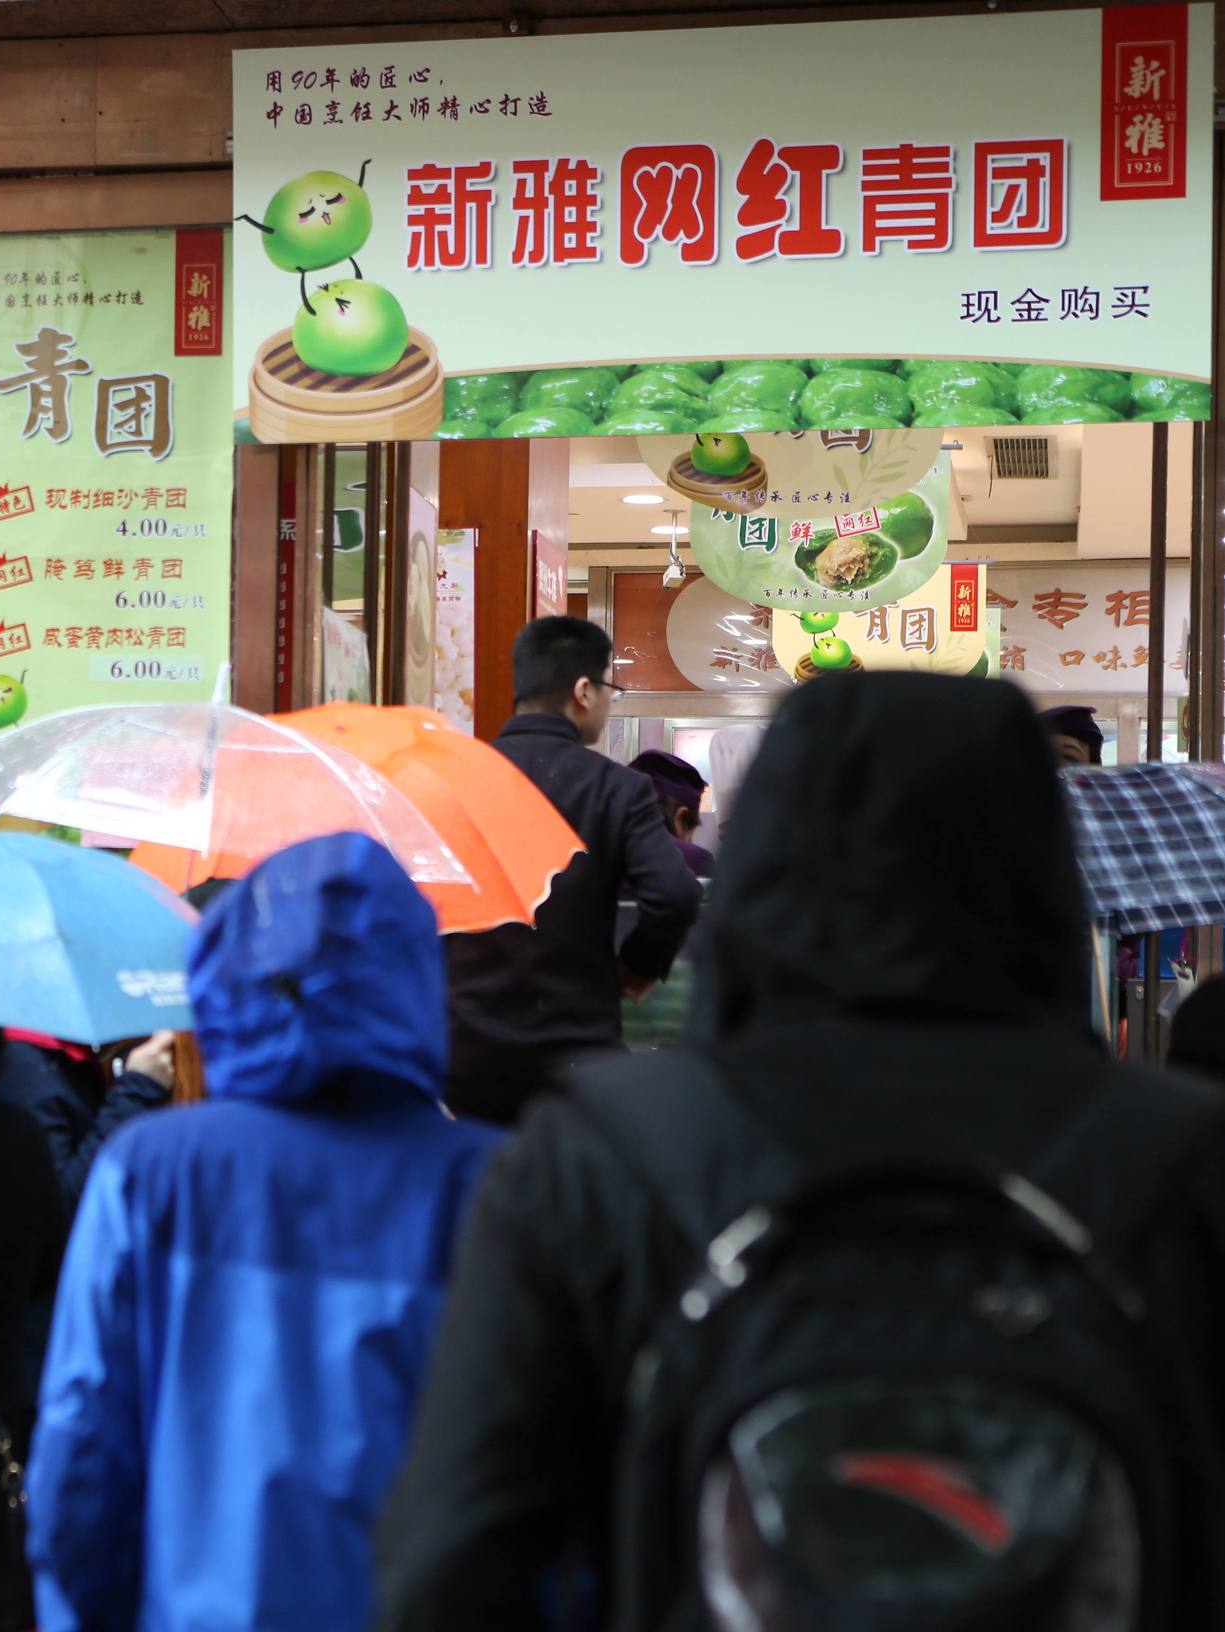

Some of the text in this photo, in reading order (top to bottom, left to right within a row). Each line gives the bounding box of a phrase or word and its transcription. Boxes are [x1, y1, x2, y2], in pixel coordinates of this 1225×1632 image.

[265, 91, 553, 129] 中国烹饪大师精心打造
[1124, 56, 1166, 157] 新雅
[1126, 162, 1163, 175] 1926
[405, 138, 1067, 270] 新雅网红青团
[187, 272, 211, 331] 新雅
[959, 285, 1151, 324] 现金购买
[188, 333, 209, 342] 1926
[45, 487, 188, 510] 现制细沙青团
[722, 490, 852, 504] 百年传承 匠心专注
[789, 521, 816, 547] 鲜
[43, 558, 184, 581] 腌笃鲜青团
[763, 588, 871, 600] 百年传承 匠心专注
[957, 584, 972, 617] 新雅
[42, 626, 187, 650] 咸蛋黄肉松青团
